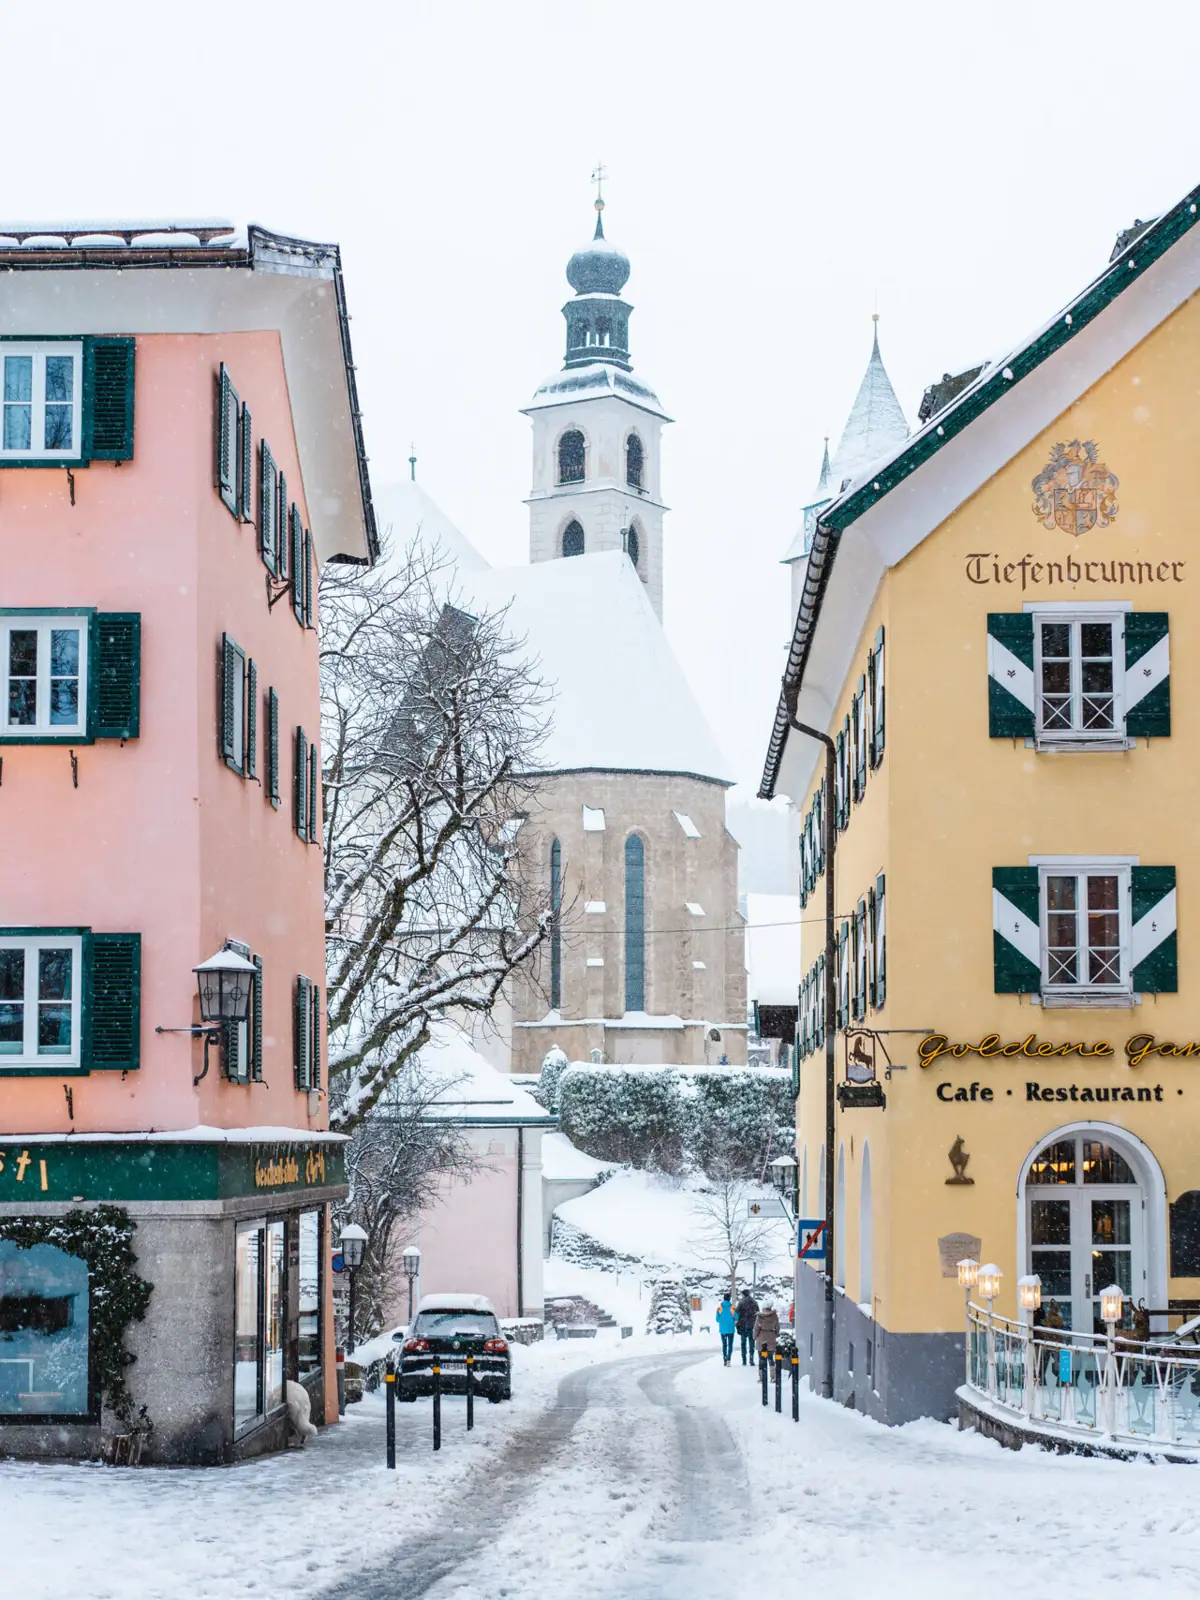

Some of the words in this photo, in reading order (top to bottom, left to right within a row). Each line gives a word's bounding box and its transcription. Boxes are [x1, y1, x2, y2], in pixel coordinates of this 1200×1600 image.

[964, 552, 1187, 591] Tiefenbrunner
[918, 1034, 1114, 1068] Goldene
[936, 1082, 994, 1102] Cafe
[1026, 1082, 1163, 1102] Restaurant
